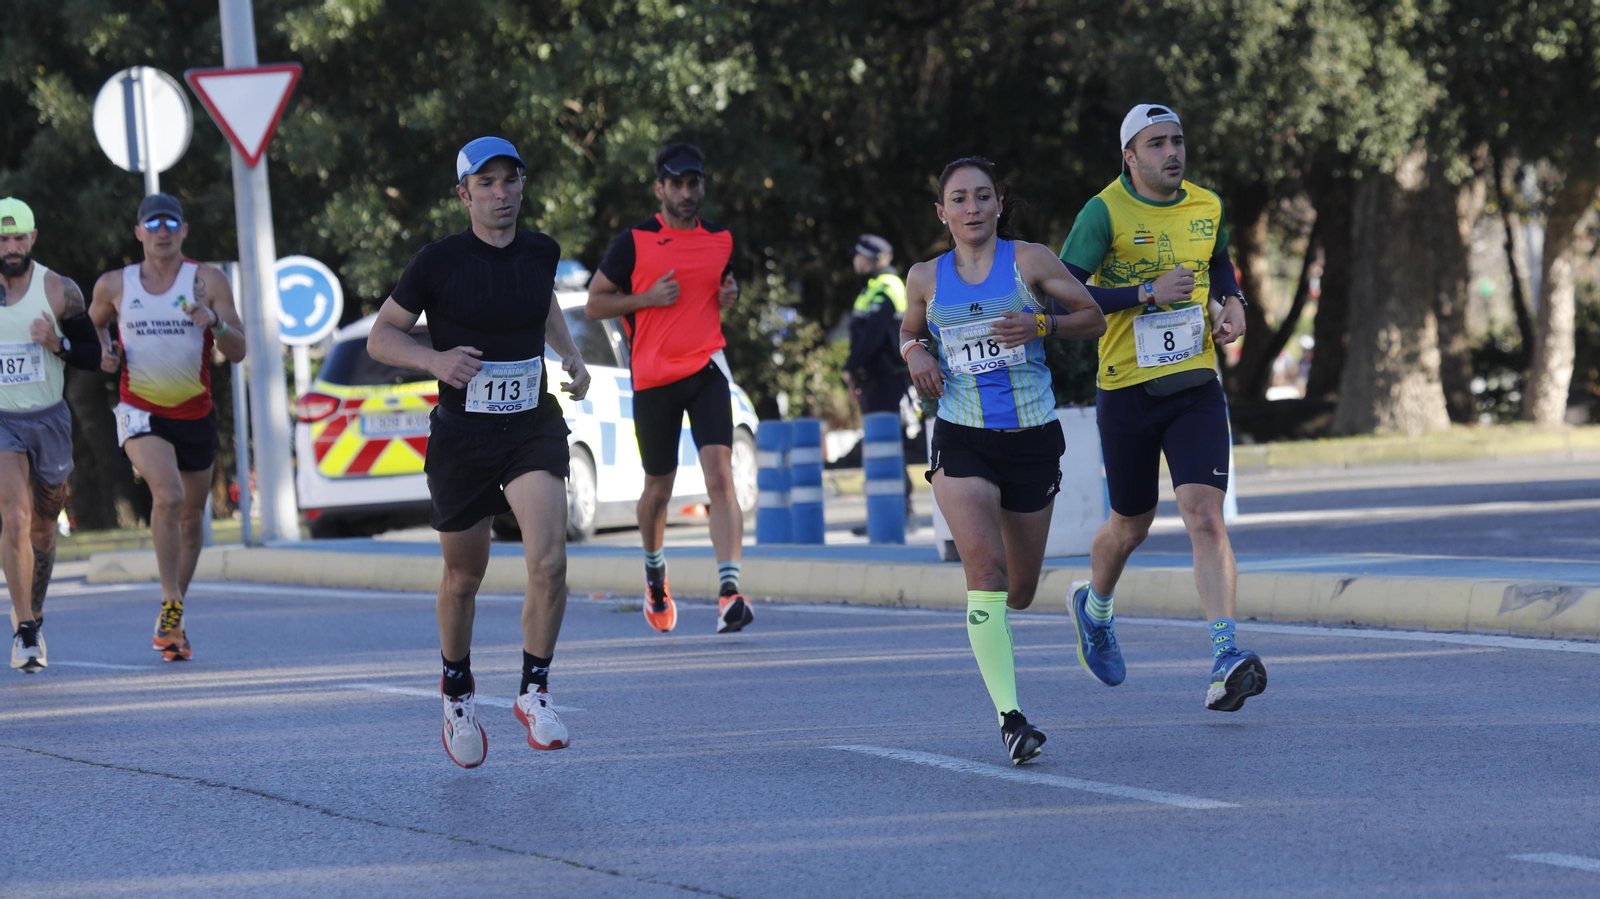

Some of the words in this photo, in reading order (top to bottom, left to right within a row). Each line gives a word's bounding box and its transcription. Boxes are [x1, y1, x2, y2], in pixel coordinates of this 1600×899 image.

[126, 320, 148, 329] CLUB
[151, 319, 194, 327] TRIATLÓN
[1163, 331, 1175, 351] 8
[962, 339, 1000, 361] 118
[1157, 352, 1189, 363] EVOS
[0, 358, 25, 374] 187
[969, 360, 1006, 372] EVOS
[485, 381, 520, 401] 113
